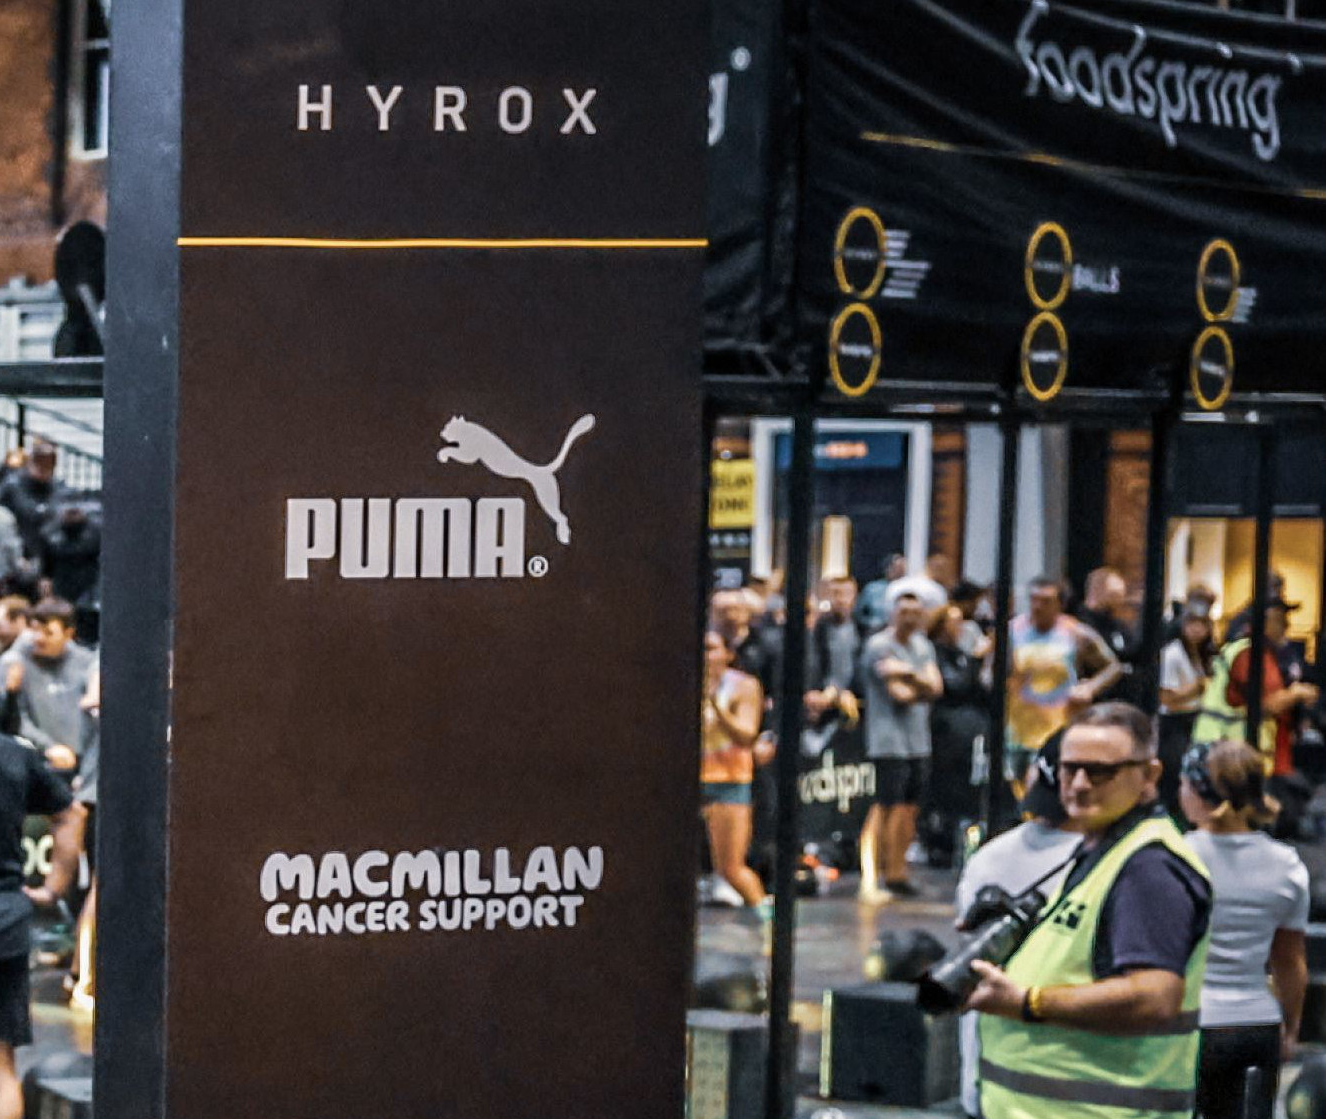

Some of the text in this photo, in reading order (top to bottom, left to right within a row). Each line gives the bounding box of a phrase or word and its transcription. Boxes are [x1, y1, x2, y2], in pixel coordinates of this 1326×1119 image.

[297, 84, 598, 135] HYROX
[259, 846, 604, 901] MACMILLAN
[265, 895, 585, 935] CANCER SUPPORT
